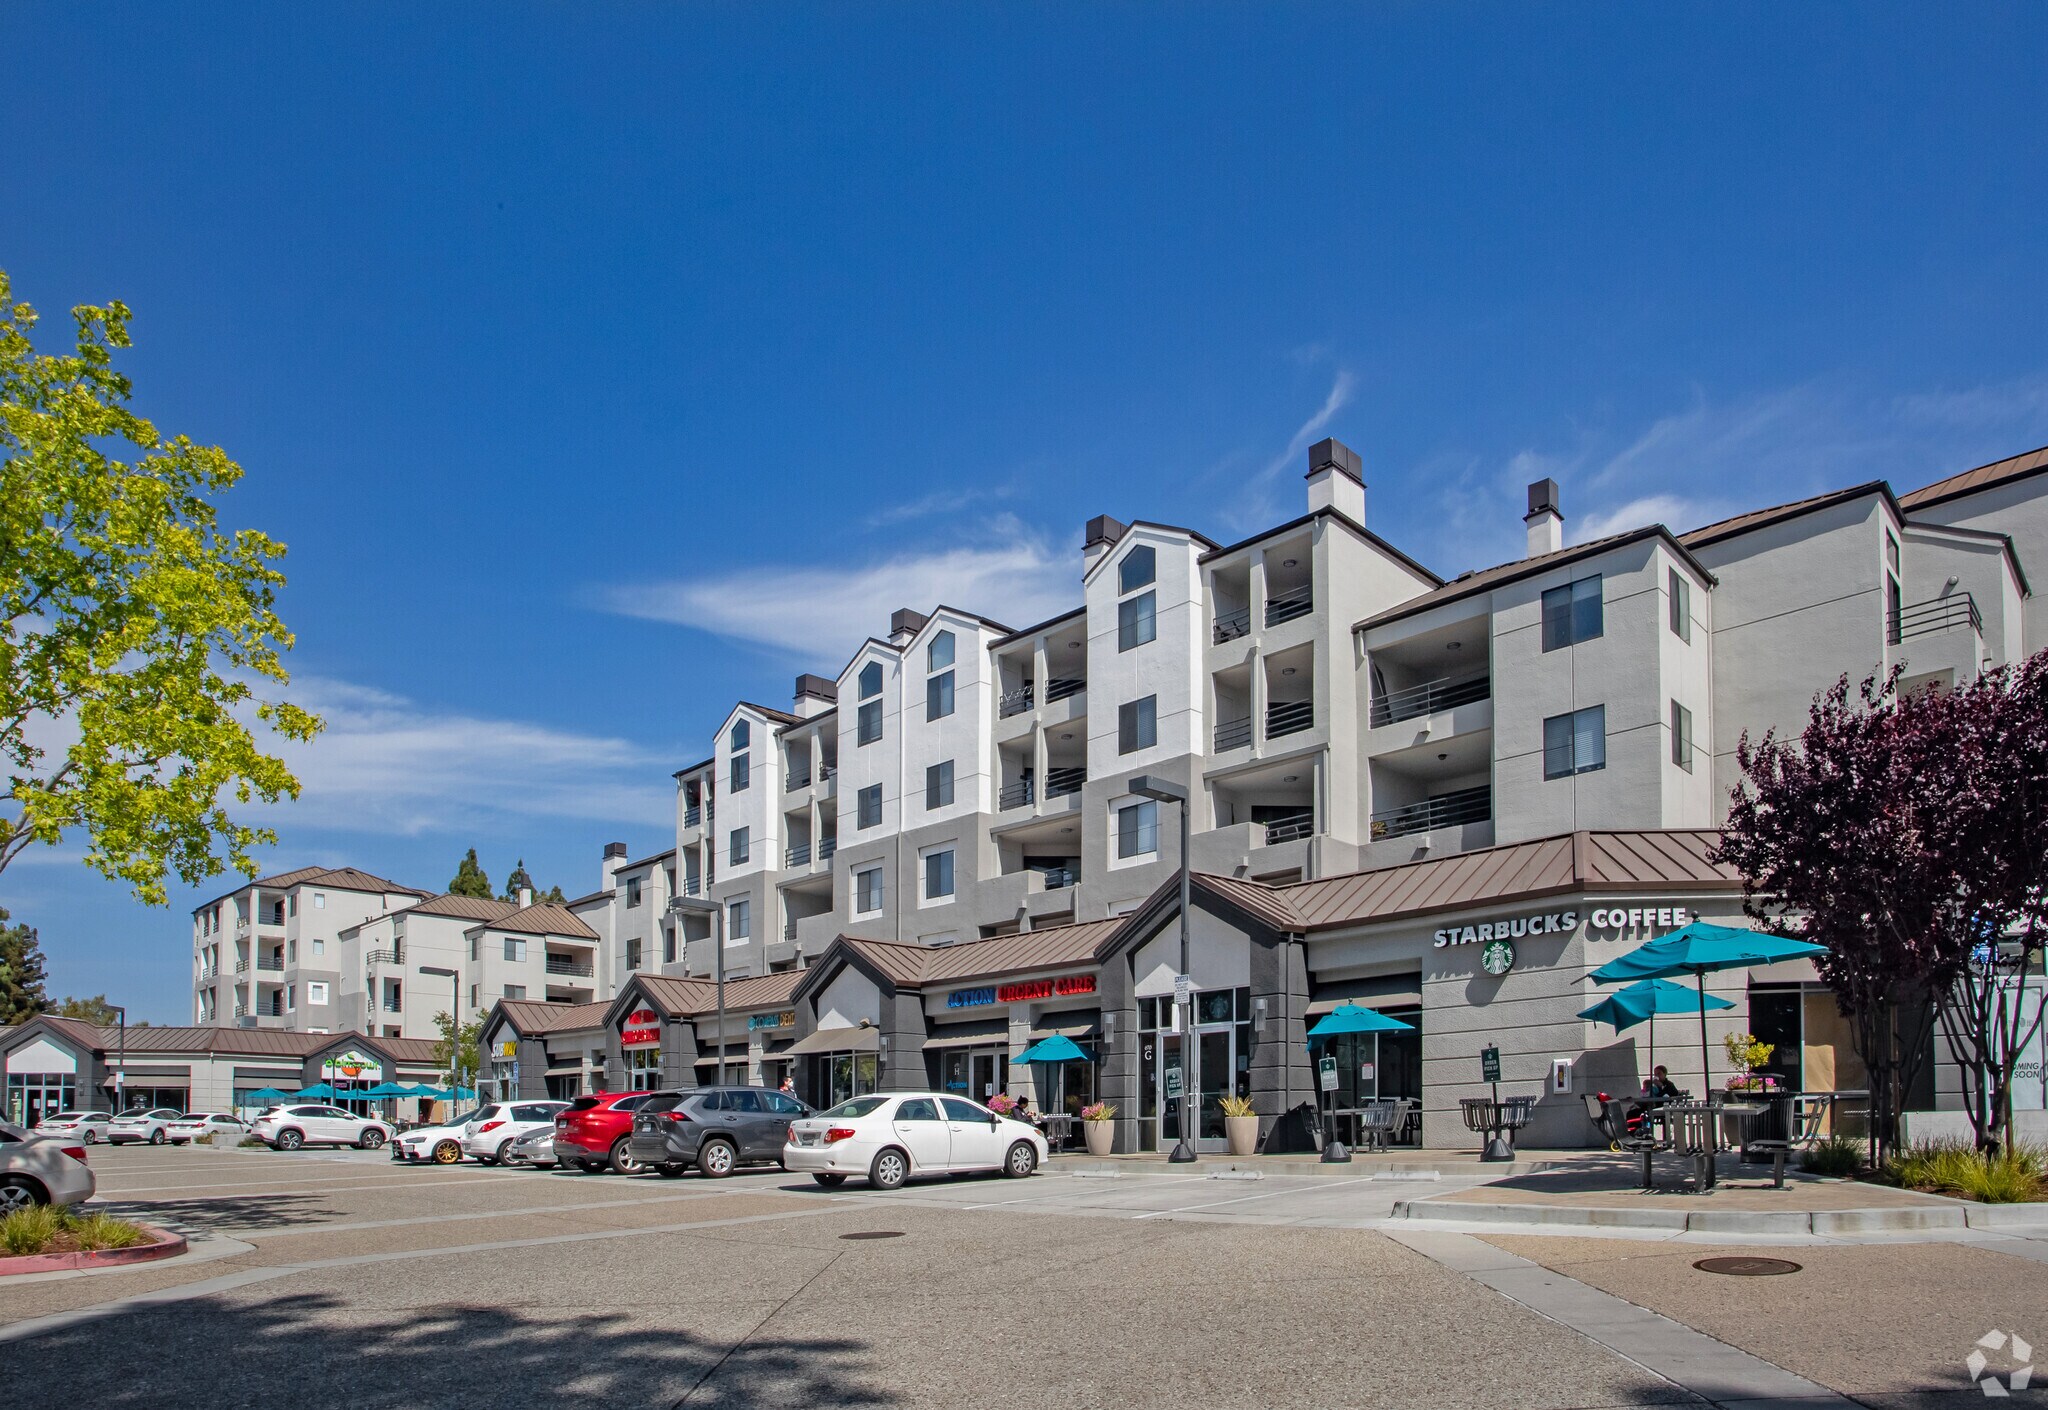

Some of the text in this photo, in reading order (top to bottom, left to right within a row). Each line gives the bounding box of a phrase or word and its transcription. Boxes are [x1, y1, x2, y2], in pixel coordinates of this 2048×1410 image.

[1433, 907, 1687, 948] STARBUCKS COFFEE
[945, 975, 1095, 1008] ACTION URGENT CARE
[491, 1041, 517, 1058] SUBWAY
[1144, 1050, 1152, 1060] G
[2014, 1070, 2039, 1079] SOON
